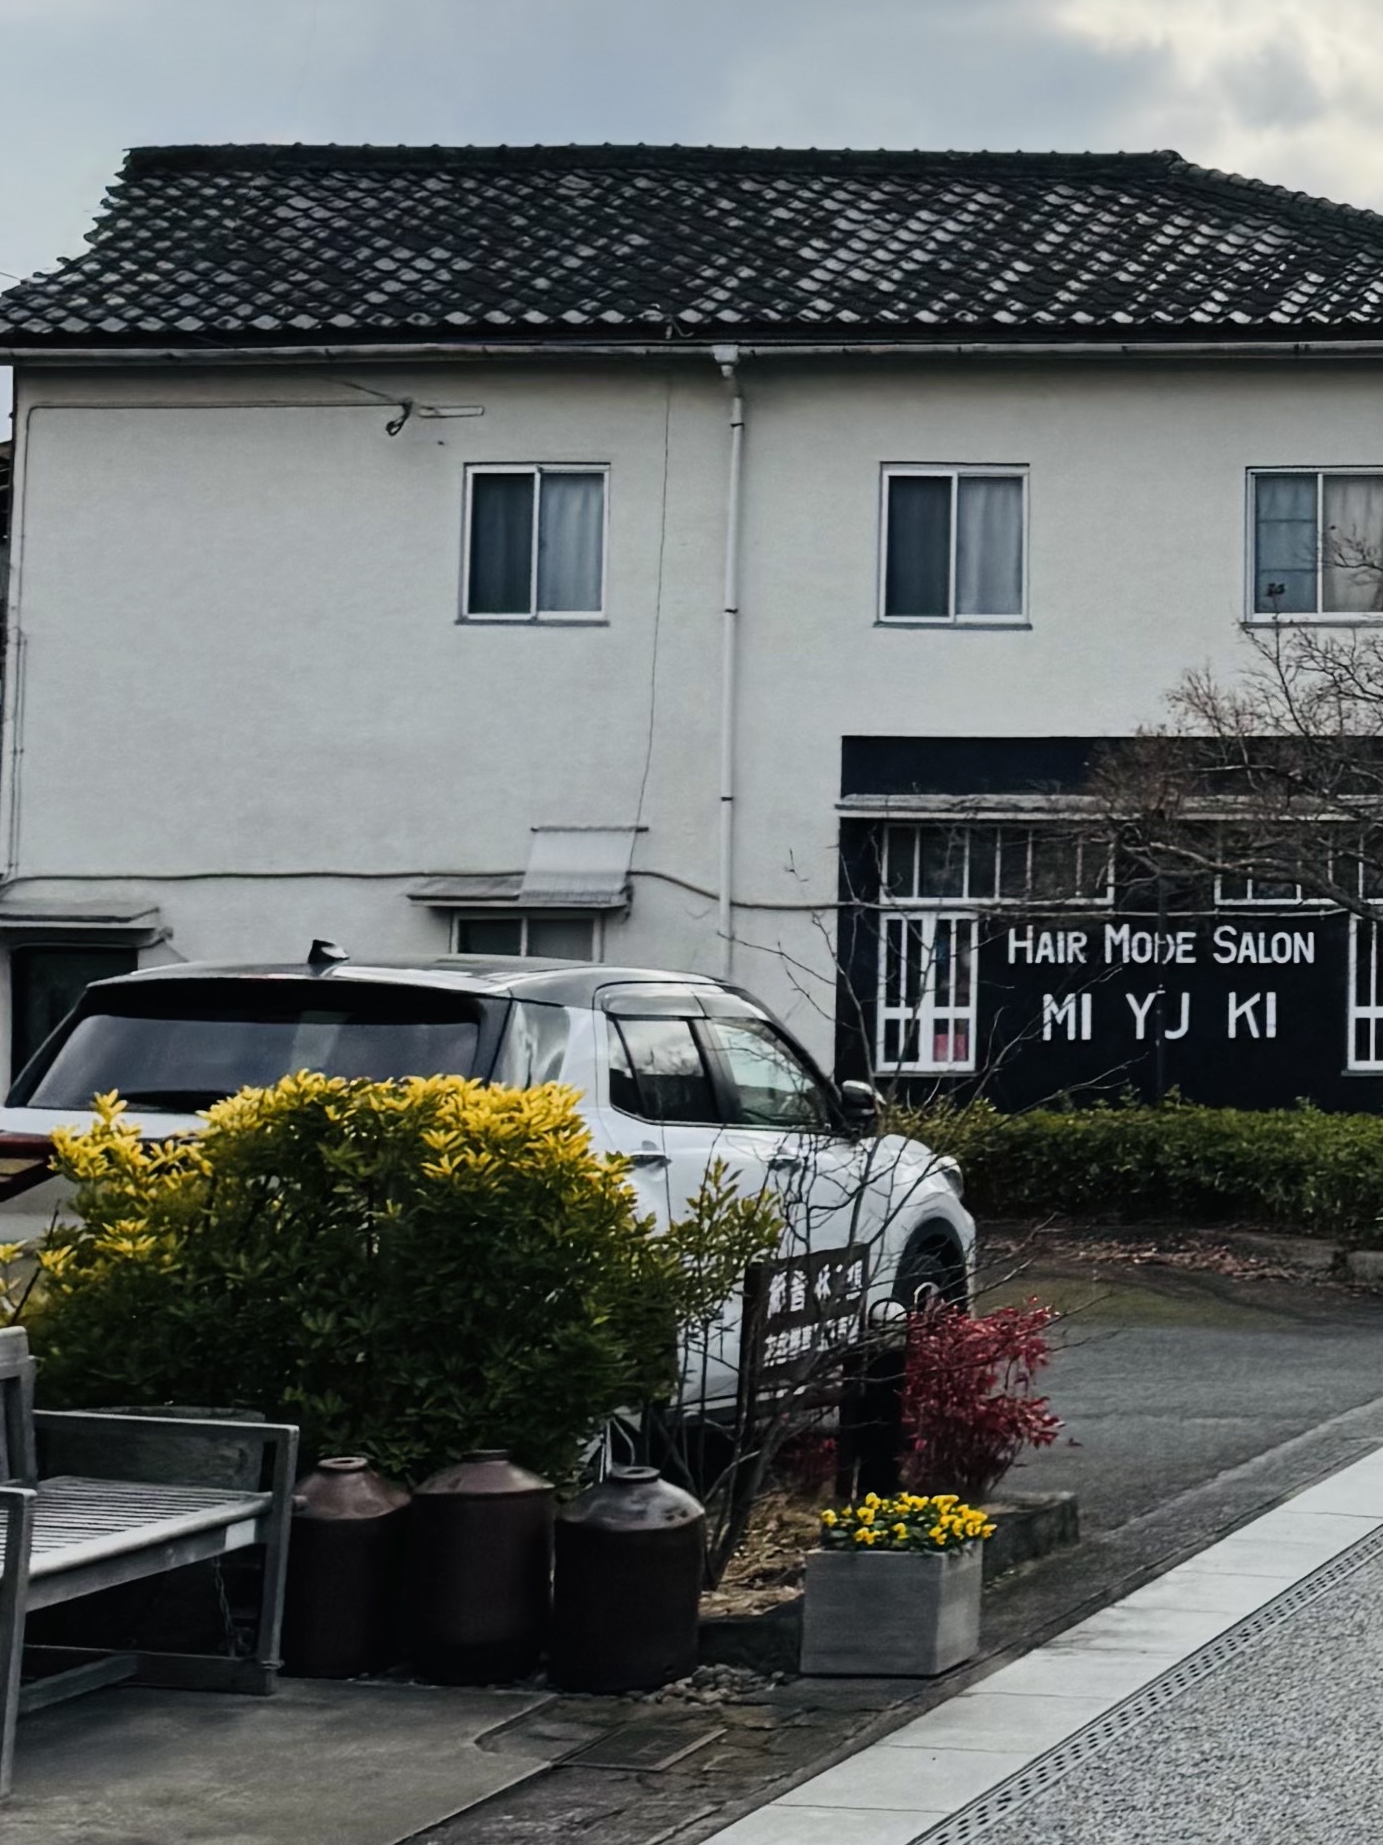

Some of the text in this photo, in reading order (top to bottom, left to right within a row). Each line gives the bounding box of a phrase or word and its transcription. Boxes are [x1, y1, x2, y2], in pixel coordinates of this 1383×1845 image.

[1008, 923, 1315, 964] HAIR MODE SALON
[1042, 992, 1092, 1041] MI
[1227, 991, 1277, 1039] KI
